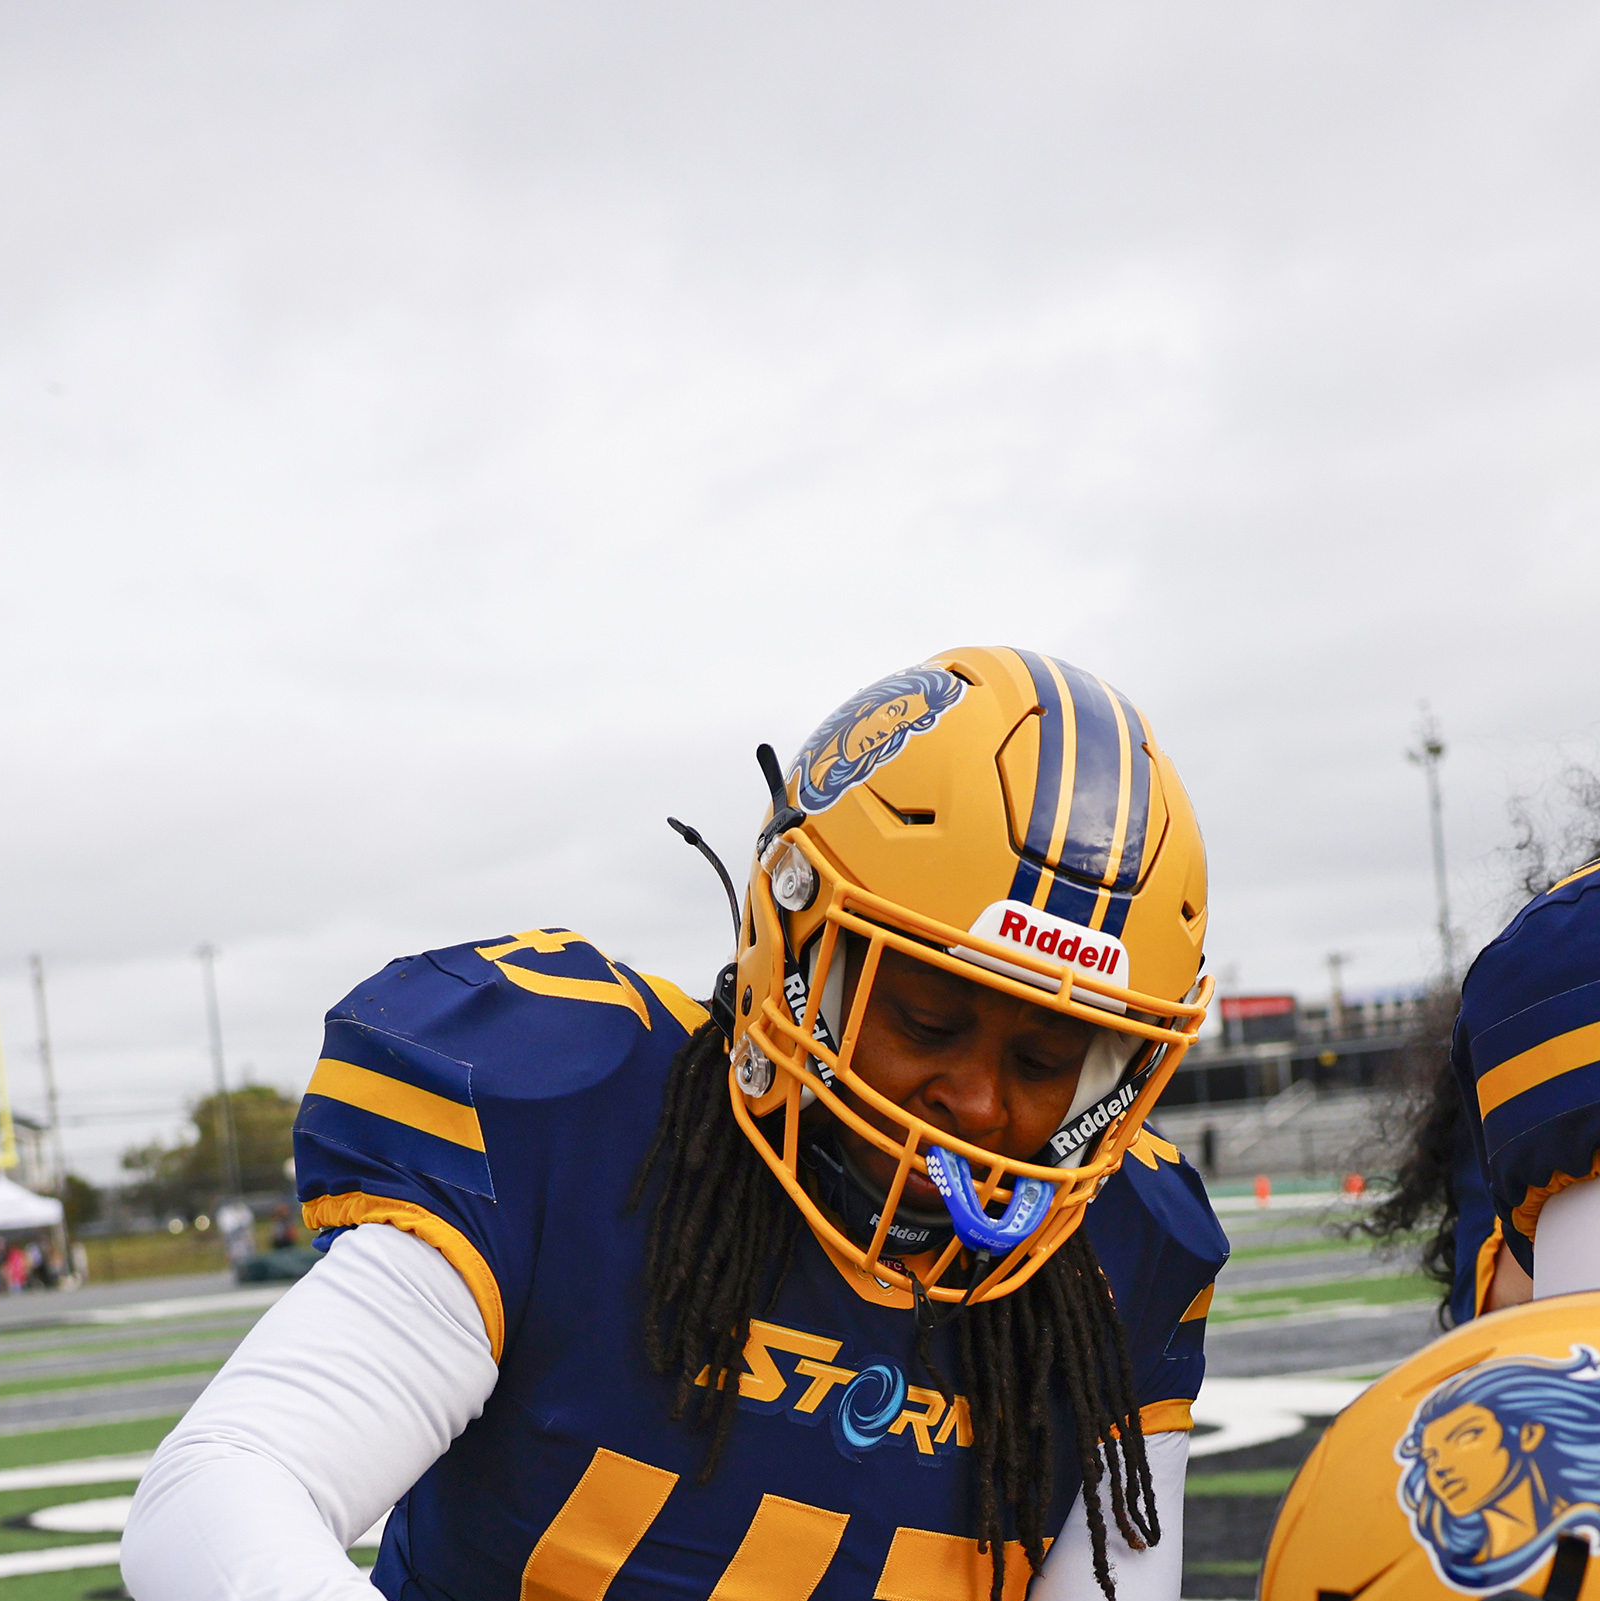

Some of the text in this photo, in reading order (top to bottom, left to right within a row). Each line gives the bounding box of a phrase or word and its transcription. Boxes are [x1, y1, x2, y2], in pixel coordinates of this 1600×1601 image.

[999, 909, 1121, 975] Riddell
[1050, 1083, 1135, 1158] Riddell
[869, 1213, 931, 1242] Rddell
